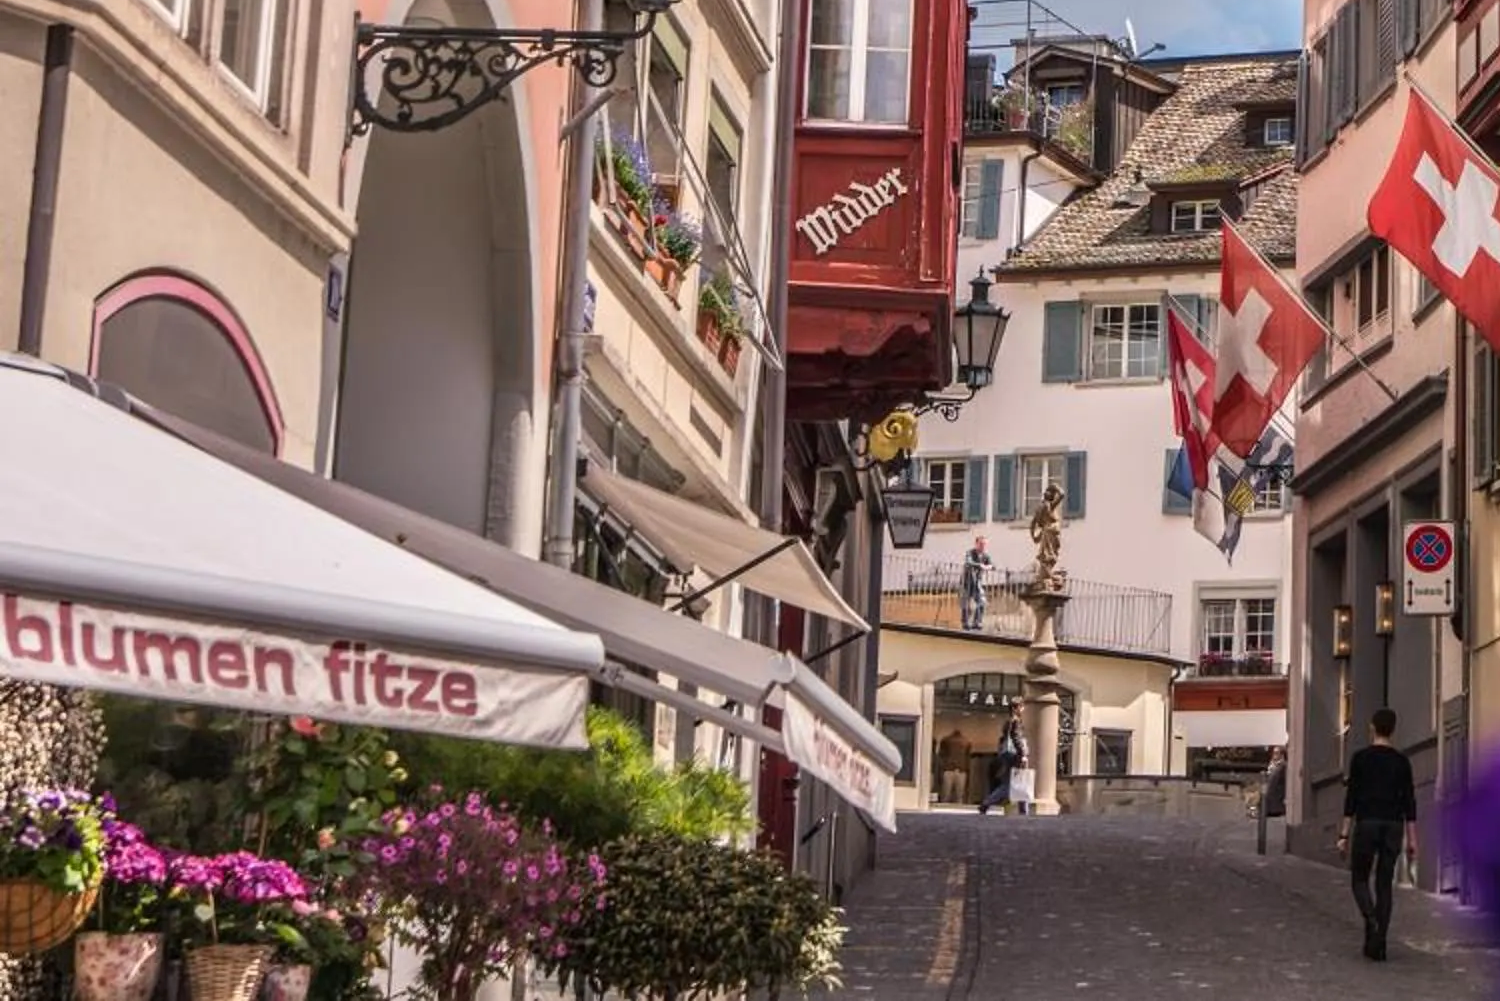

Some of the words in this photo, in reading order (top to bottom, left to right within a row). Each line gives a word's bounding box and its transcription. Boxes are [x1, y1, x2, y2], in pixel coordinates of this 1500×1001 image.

[795, 167, 909, 254] Widder
[4, 594, 295, 695] blumen
[323, 640, 478, 716] fitze
[968, 691, 1010, 706] FAL
